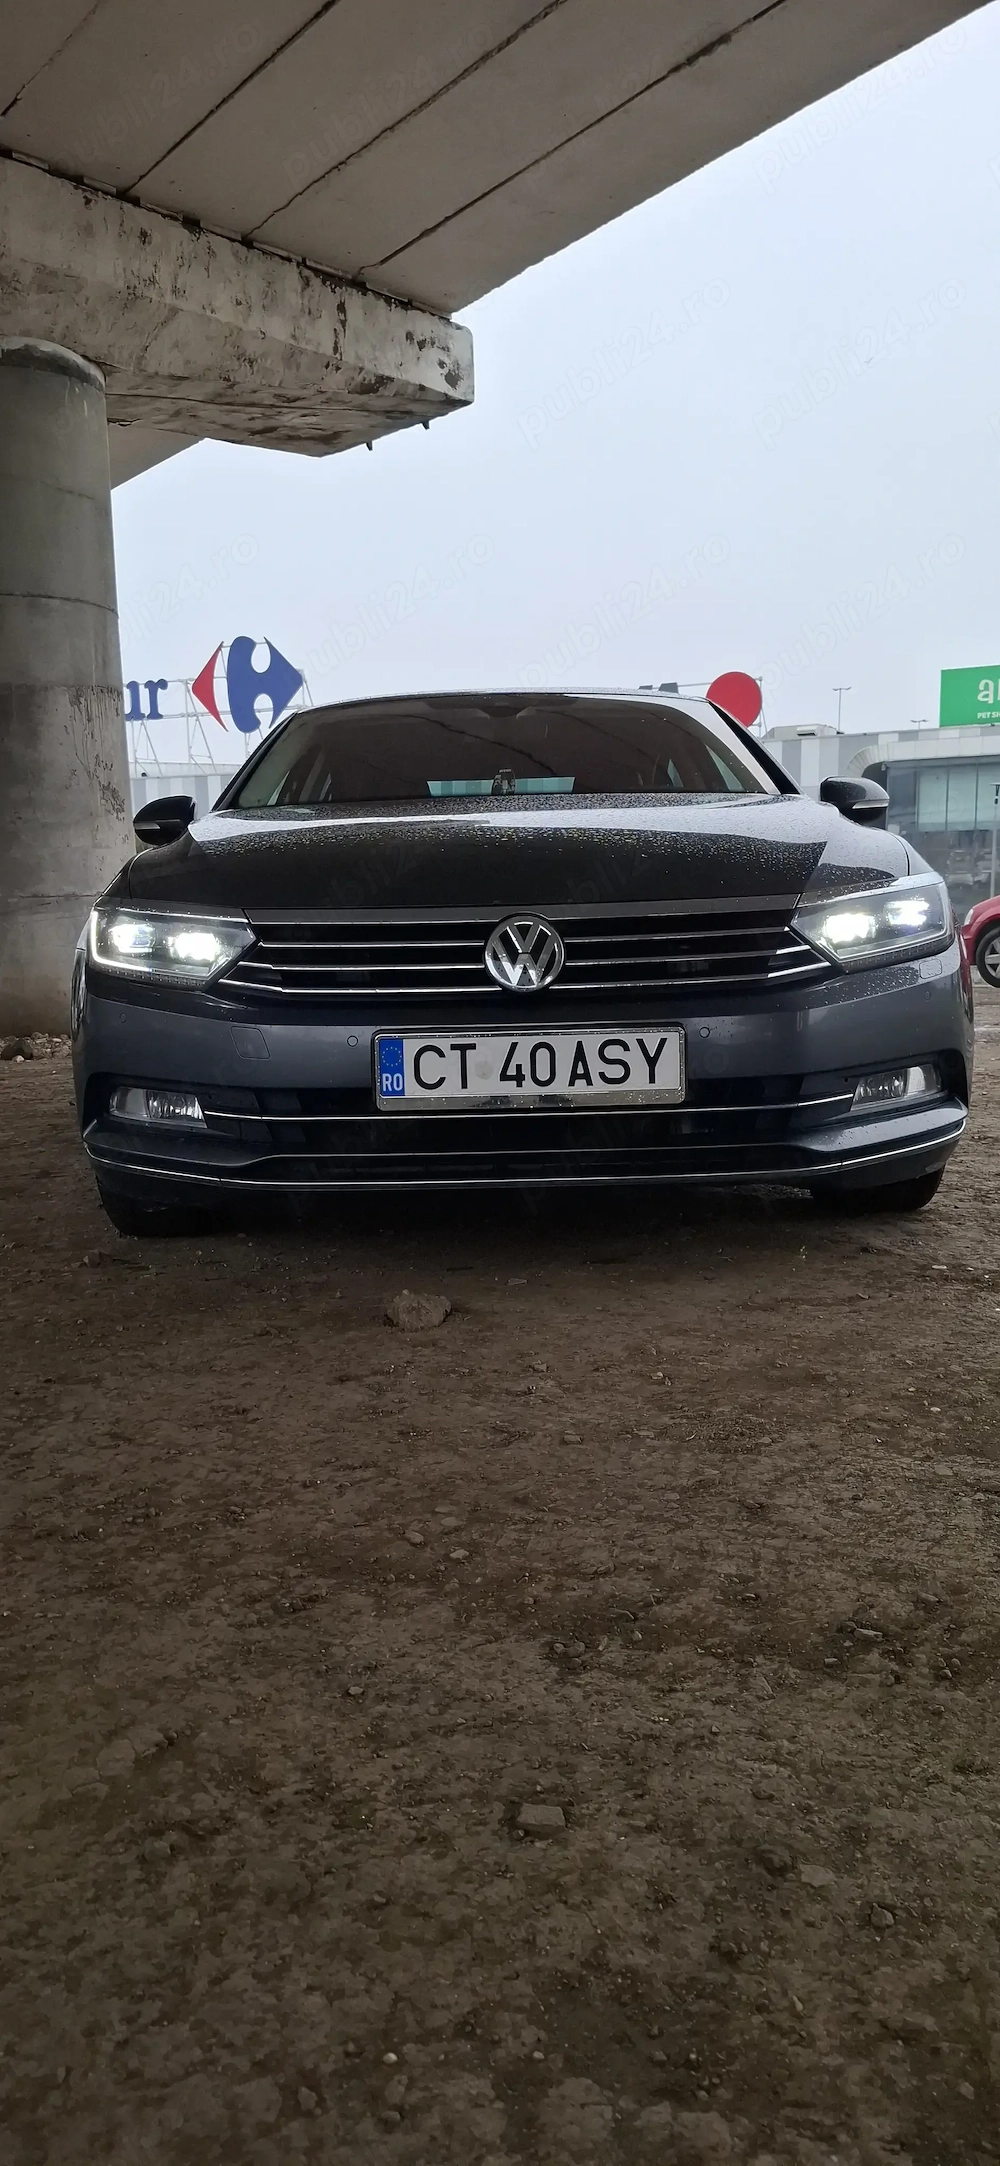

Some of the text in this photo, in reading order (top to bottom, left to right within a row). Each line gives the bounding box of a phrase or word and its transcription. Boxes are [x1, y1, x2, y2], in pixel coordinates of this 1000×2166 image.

[977, 679, 1000, 704] a
[413, 1037, 668, 1090] CT 40 ASY
[382, 1073, 403, 1091] RO
